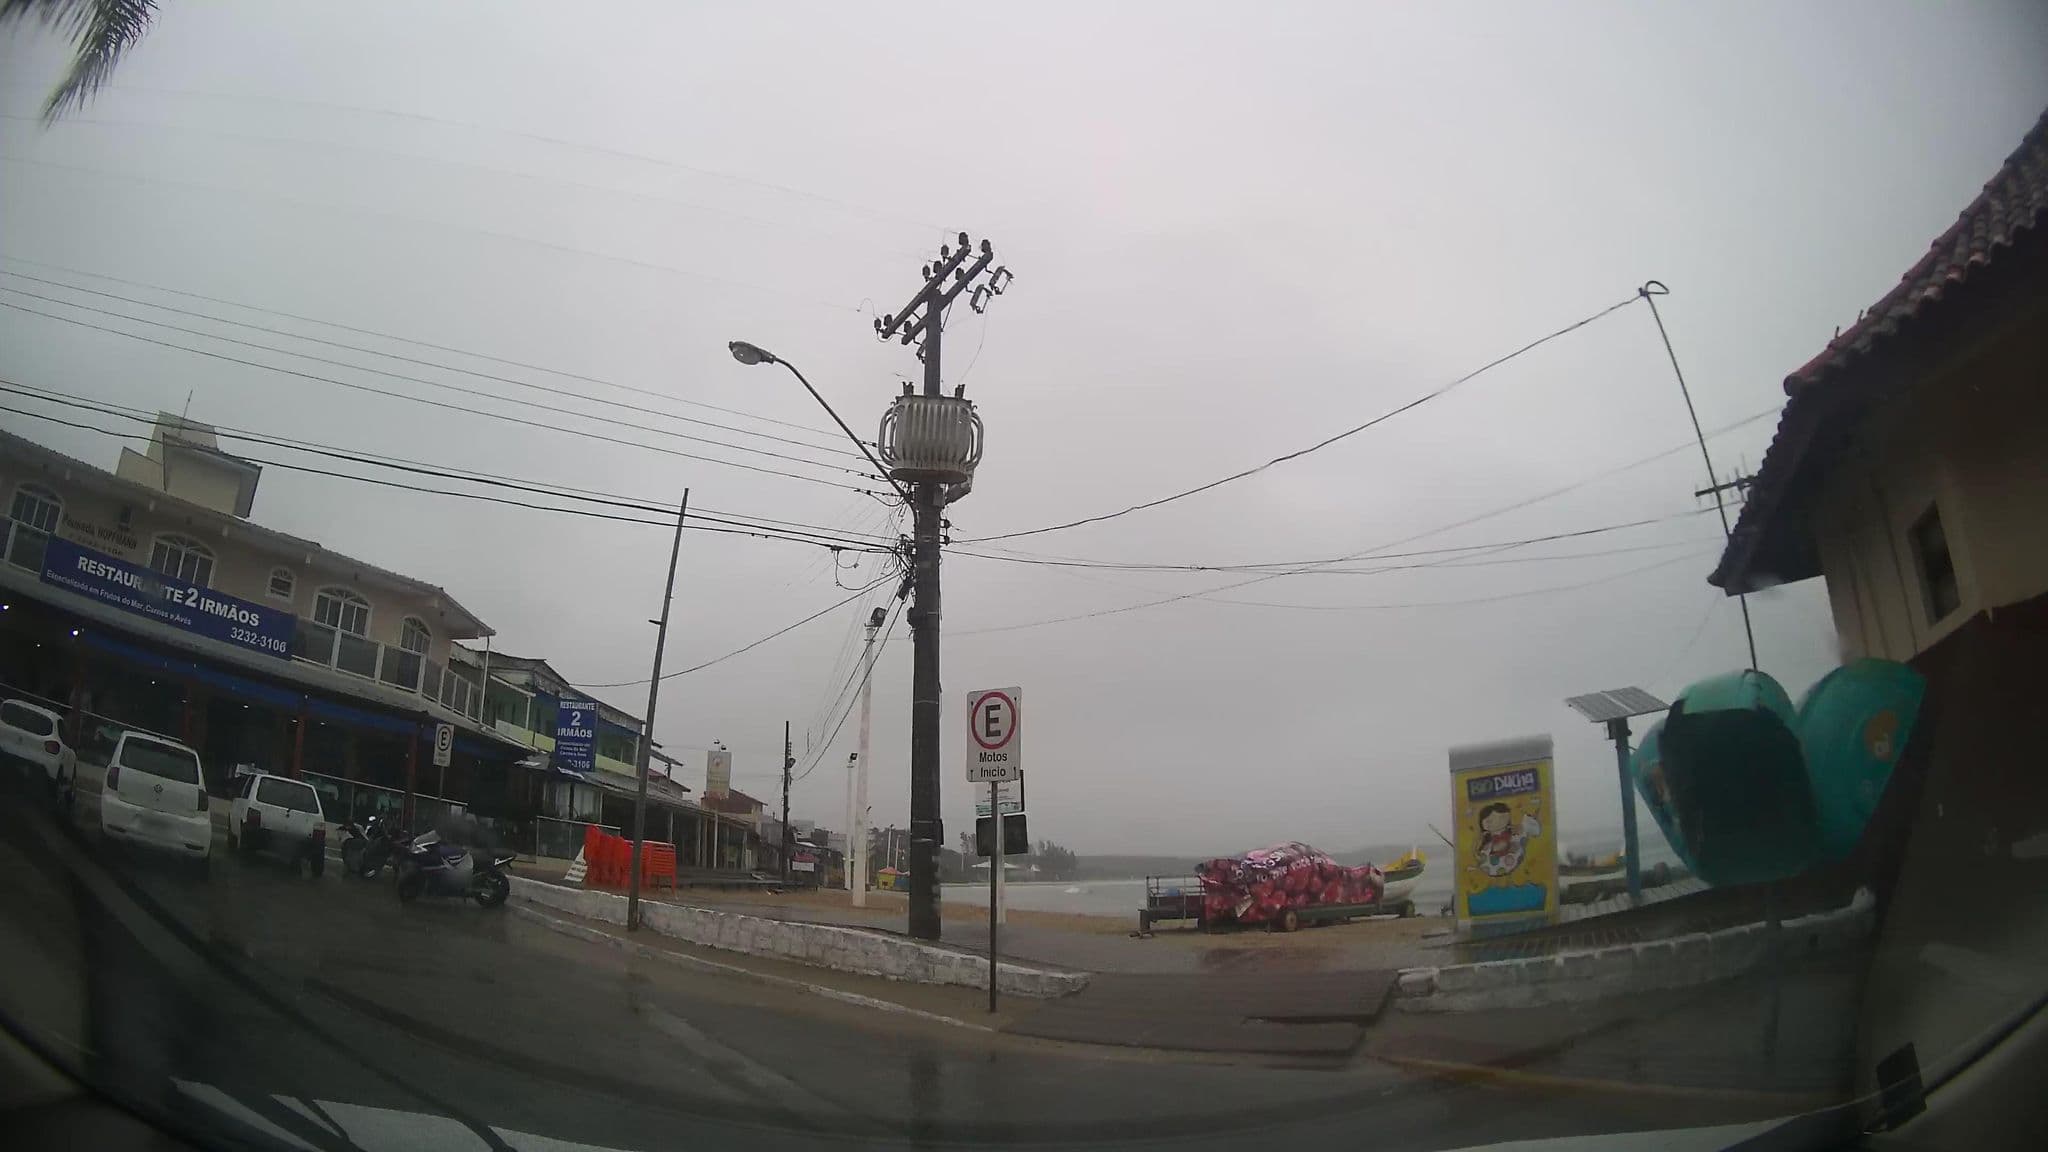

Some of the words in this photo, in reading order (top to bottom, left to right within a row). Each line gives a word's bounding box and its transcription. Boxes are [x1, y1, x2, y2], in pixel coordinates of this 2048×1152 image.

[77, 556, 184, 604] RESTAURTE
[184, 587, 199, 608] 2
[199, 597, 260, 627] IRMÃOS
[230, 626, 287, 653] 3232-3106
[560, 701, 596, 711] RESTAURANTE
[571, 710, 581, 727] 2
[985, 703, 1002, 738] E
[440, 731, 448, 747] E
[557, 727, 593, 738] IRMÃOS
[979, 751, 1008, 763] Motos
